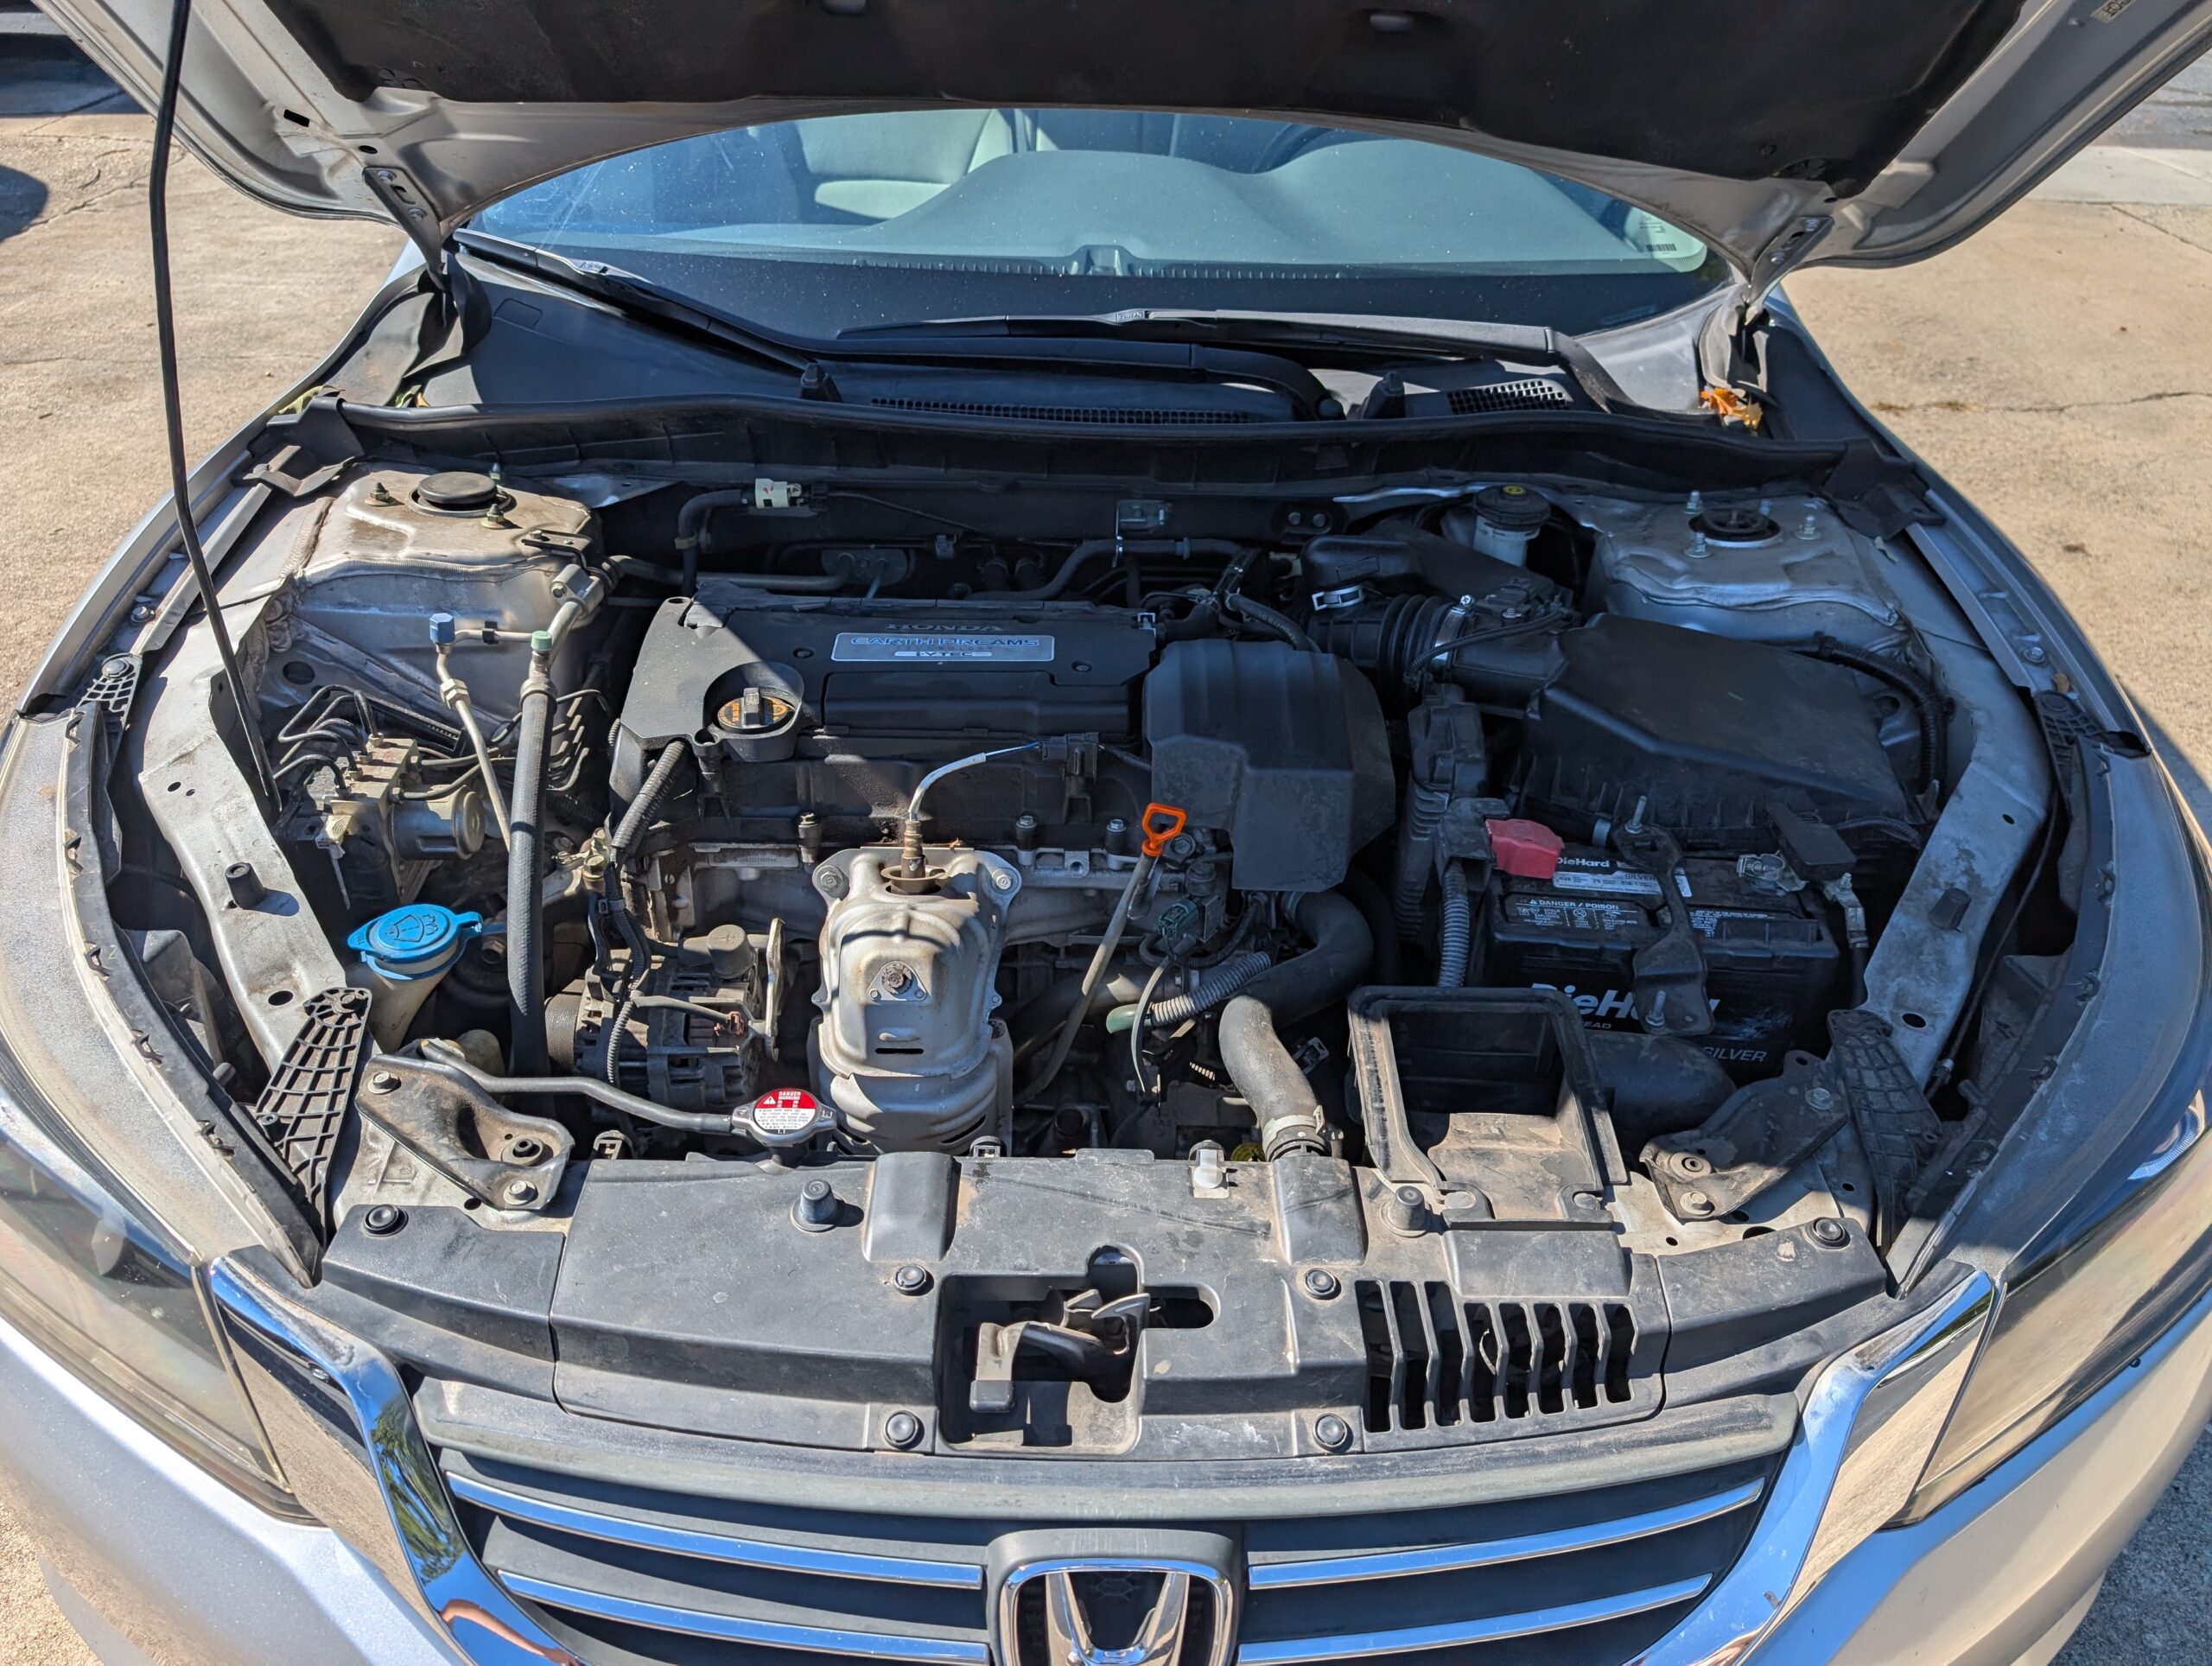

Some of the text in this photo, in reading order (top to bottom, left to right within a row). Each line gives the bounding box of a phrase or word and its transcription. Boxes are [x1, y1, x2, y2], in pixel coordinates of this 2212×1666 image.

[886, 623, 1005, 632] HONDA
[850, 637, 1040, 647] EARTH DREAMS
